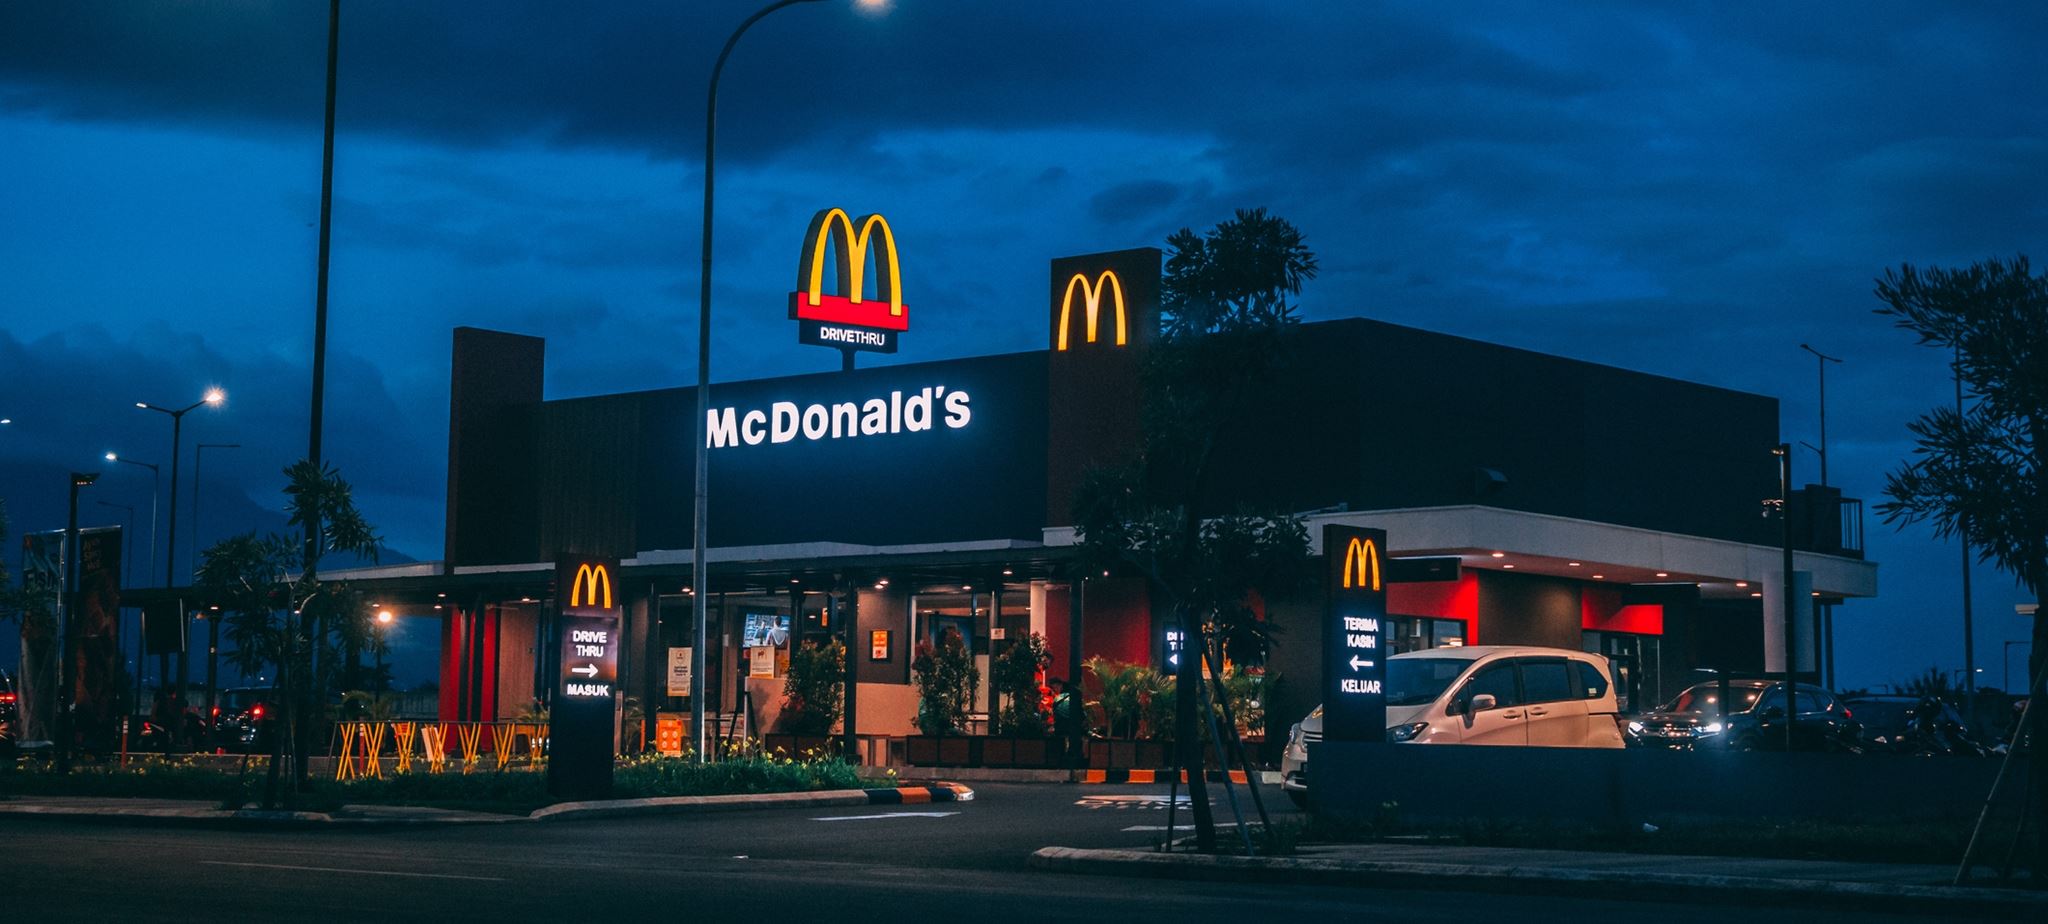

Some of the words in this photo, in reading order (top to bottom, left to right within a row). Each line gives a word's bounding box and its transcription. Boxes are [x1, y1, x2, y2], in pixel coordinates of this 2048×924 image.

[820, 326, 885, 346] DRIVETHRU
[706, 386, 971, 449] McDonald's
[1344, 617, 1379, 632] TERIMA
[573, 630, 607, 643] DRIVE
[1347, 634, 1375, 648] KASIH
[576, 645, 604, 657] THRU
[567, 684, 609, 696] MASUK
[1341, 679, 1381, 694] KELUAR
